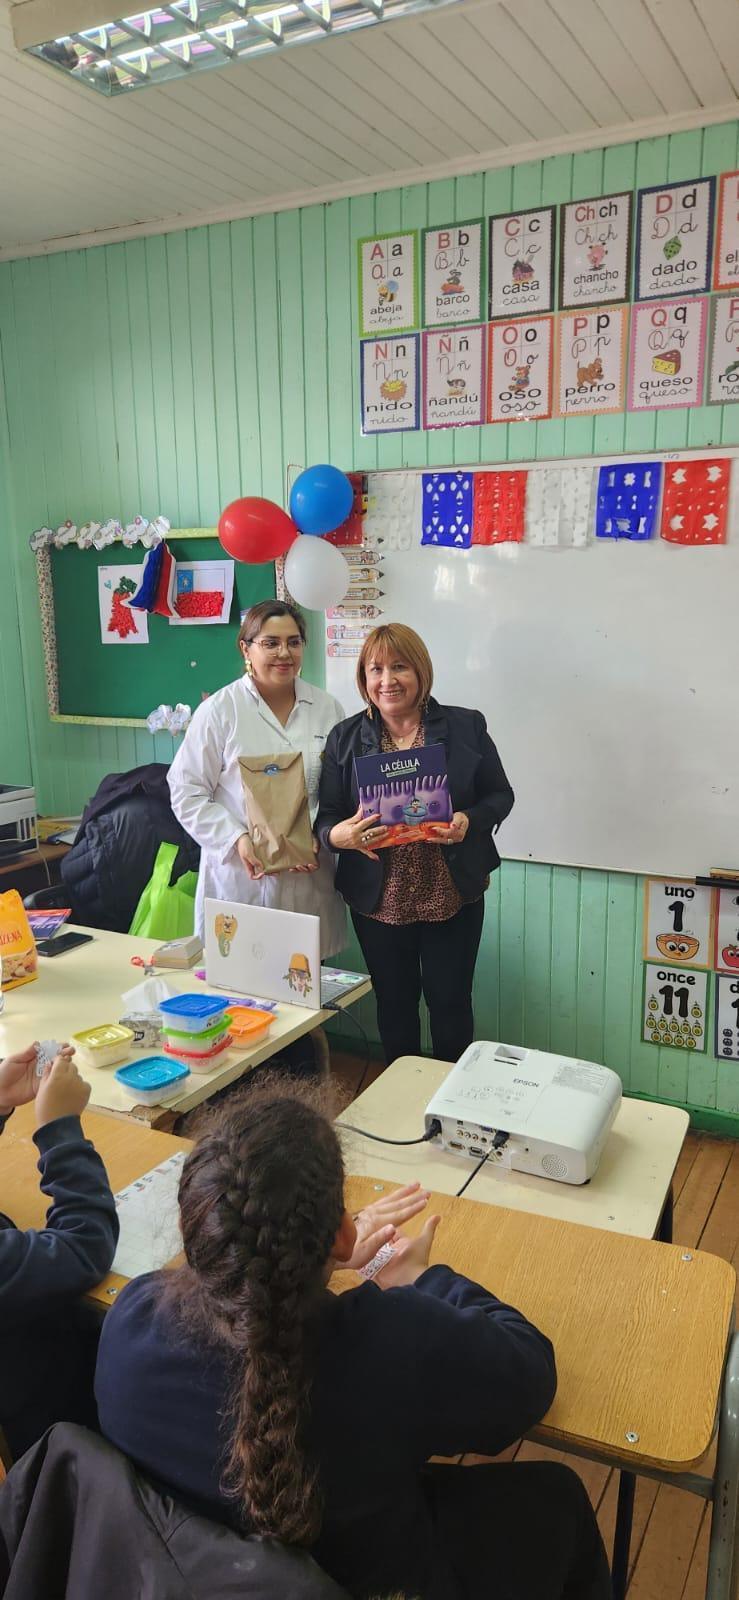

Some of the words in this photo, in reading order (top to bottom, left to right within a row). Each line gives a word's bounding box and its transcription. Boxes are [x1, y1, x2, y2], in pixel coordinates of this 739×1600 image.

[655, 194, 673, 214] D
[682, 188, 696, 209] d
[575, 206, 595, 222] Ch
[599, 202, 618, 218] ch
[505, 219, 520, 237] C
[528, 219, 540, 233] c
[651, 217, 670, 240] D
[678, 213, 697, 234] d
[438, 233, 450, 248] B
[459, 230, 469, 245] b
[575, 228, 595, 245] Ch
[598, 226, 618, 241] ch
[370, 244, 384, 260] A
[392, 243, 402, 256] a
[504, 239, 521, 257] C
[526, 244, 542, 255] c
[434, 252, 453, 270] B
[457, 249, 471, 267] b
[392, 266, 404, 277] a
[652, 260, 697, 276] dado
[574, 269, 618, 284] chancho
[649, 274, 699, 290] dado
[502, 281, 539, 294] casa
[573, 284, 617, 297] chancho
[436, 294, 470, 306] barco
[502, 294, 540, 306] casa
[370, 305, 402, 315] abeja
[436, 304, 471, 318] barco
[651, 309, 667, 327] Q
[674, 305, 687, 324] q
[369, 315, 404, 324] abeja
[573, 317, 587, 336] P
[596, 314, 610, 334] p
[503, 326, 518, 344] O
[525, 328, 537, 342] o
[648, 331, 669, 350] Q
[671, 328, 689, 348] q
[375, 343, 388, 358] N
[395, 344, 406, 356] n
[440, 335, 451, 352] Ñ
[459, 336, 469, 351] ñ
[571, 338, 587, 359] P
[594, 336, 611, 355] p
[436, 354, 454, 375] Ñ
[456, 359, 471, 370] ñ
[504, 349, 517, 367] O
[526, 352, 538, 365] o
[373, 361, 392, 381] N
[393, 368, 409, 380] n
[565, 382, 615, 398] perro
[640, 375, 693, 391] queso
[429, 393, 478, 406] ñandú
[499, 387, 541, 401] oso
[639, 388, 692, 404] queso
[367, 400, 413, 412] nido
[500, 400, 542, 414] oso
[565, 395, 609, 412] perro
[369, 413, 408, 424] nido
[380, 763, 391, 772] LA
[392, 758, 420, 770] CÉLULA
[664, 886, 695, 898] uno
[668, 901, 684, 932] 1
[657, 971, 696, 985] once
[659, 985, 689, 1017] 11
[513, 1078, 539, 1088] EPSON
